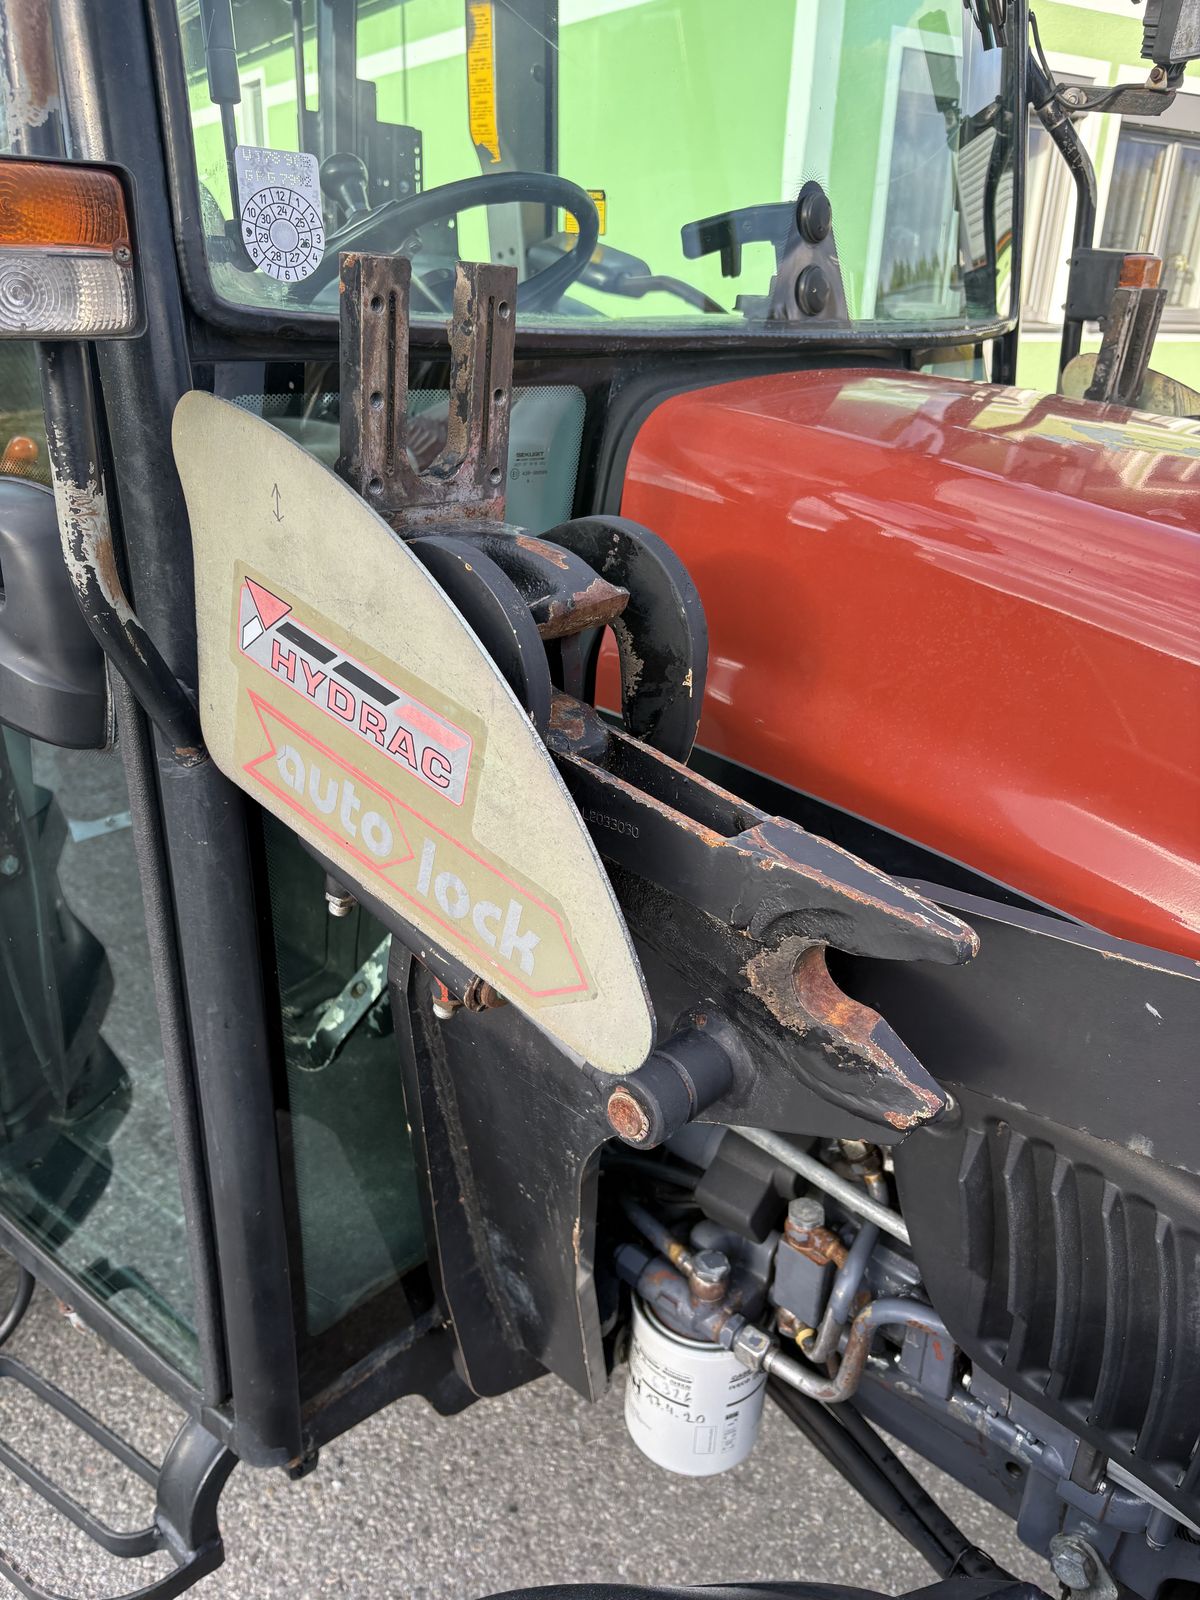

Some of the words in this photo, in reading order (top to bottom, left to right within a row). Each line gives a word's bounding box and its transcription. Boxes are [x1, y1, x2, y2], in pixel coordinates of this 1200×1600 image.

[259, 194, 267, 205] 11
[275, 191, 286, 202] 12
[295, 197, 300, 208] 1
[247, 207, 257, 218] 10
[276, 205, 288, 216] 24
[260, 214, 271, 225] 30
[295, 217, 306, 229] 25
[309, 212, 316, 223] 2
[258, 232, 269, 244] 29
[315, 233, 322, 244] 3
[252, 247, 259, 258] 8
[271, 251, 282, 262] 28
[289, 252, 300, 263] 27
[312, 252, 318, 263] 4
[266, 263, 272, 274] 7
[301, 267, 308, 277] 5
[284, 270, 291, 280] 6
[271, 639, 453, 789] HYDRAC
[276, 744, 394, 857] auto
[416, 838, 542, 977] lock
